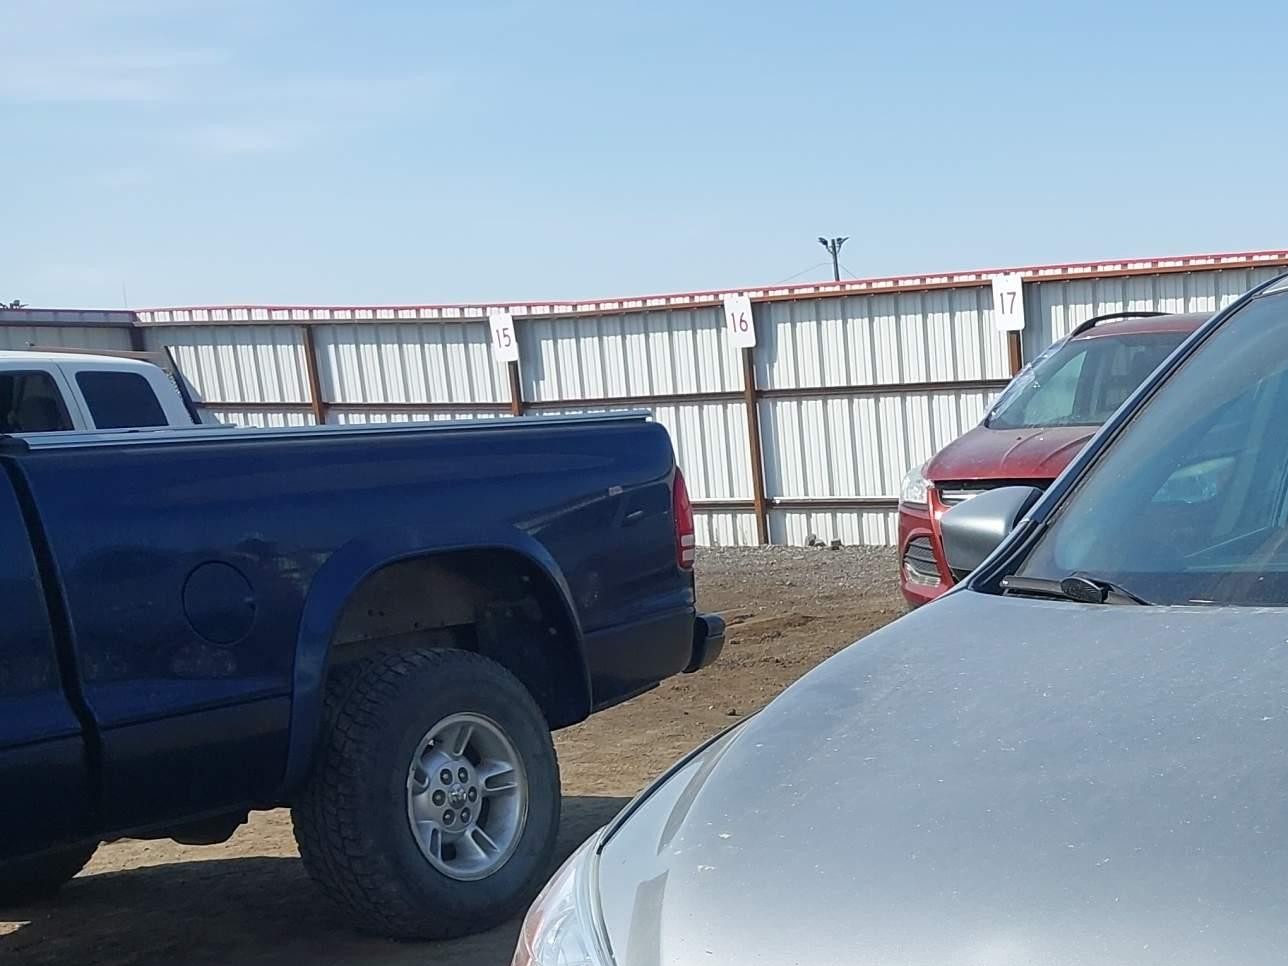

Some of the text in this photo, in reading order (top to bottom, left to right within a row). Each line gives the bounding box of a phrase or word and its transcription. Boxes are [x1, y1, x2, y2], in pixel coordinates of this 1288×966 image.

[1000, 292, 1017, 315] 17
[730, 311, 749, 334] 16
[495, 327, 511, 348] 15
